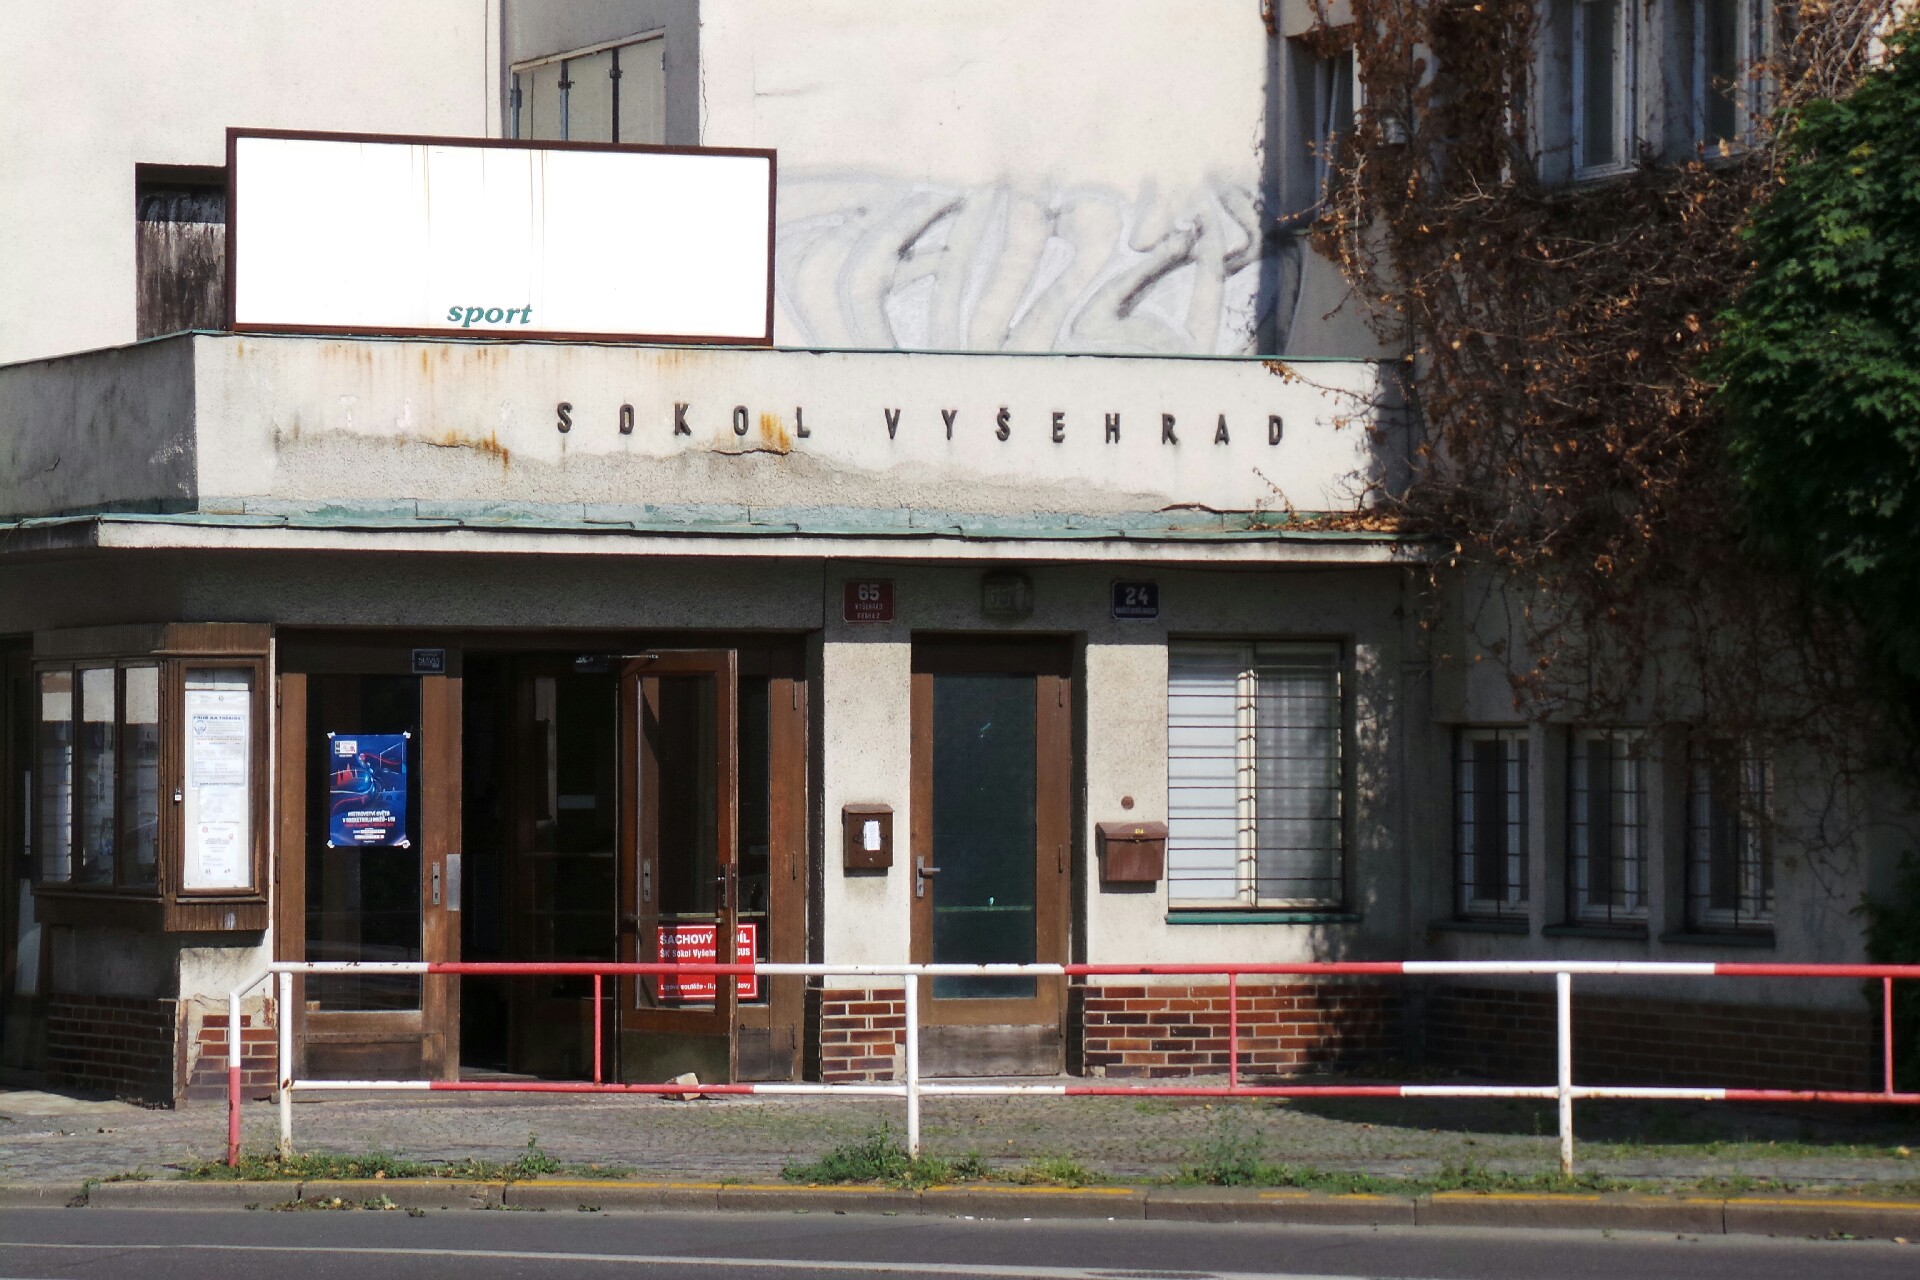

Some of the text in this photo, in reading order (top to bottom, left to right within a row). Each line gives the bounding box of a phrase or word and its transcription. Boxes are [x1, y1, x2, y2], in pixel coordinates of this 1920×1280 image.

[446, 303, 533, 328] sport
[556, 402, 1284, 446] SOKOL VYŠEHRAD
[858, 583, 880, 601] 65
[1126, 586, 1148, 605] 24
[660, 931, 713, 945] ŠACHOVÝ
[672, 949, 691, 957] Sokol
